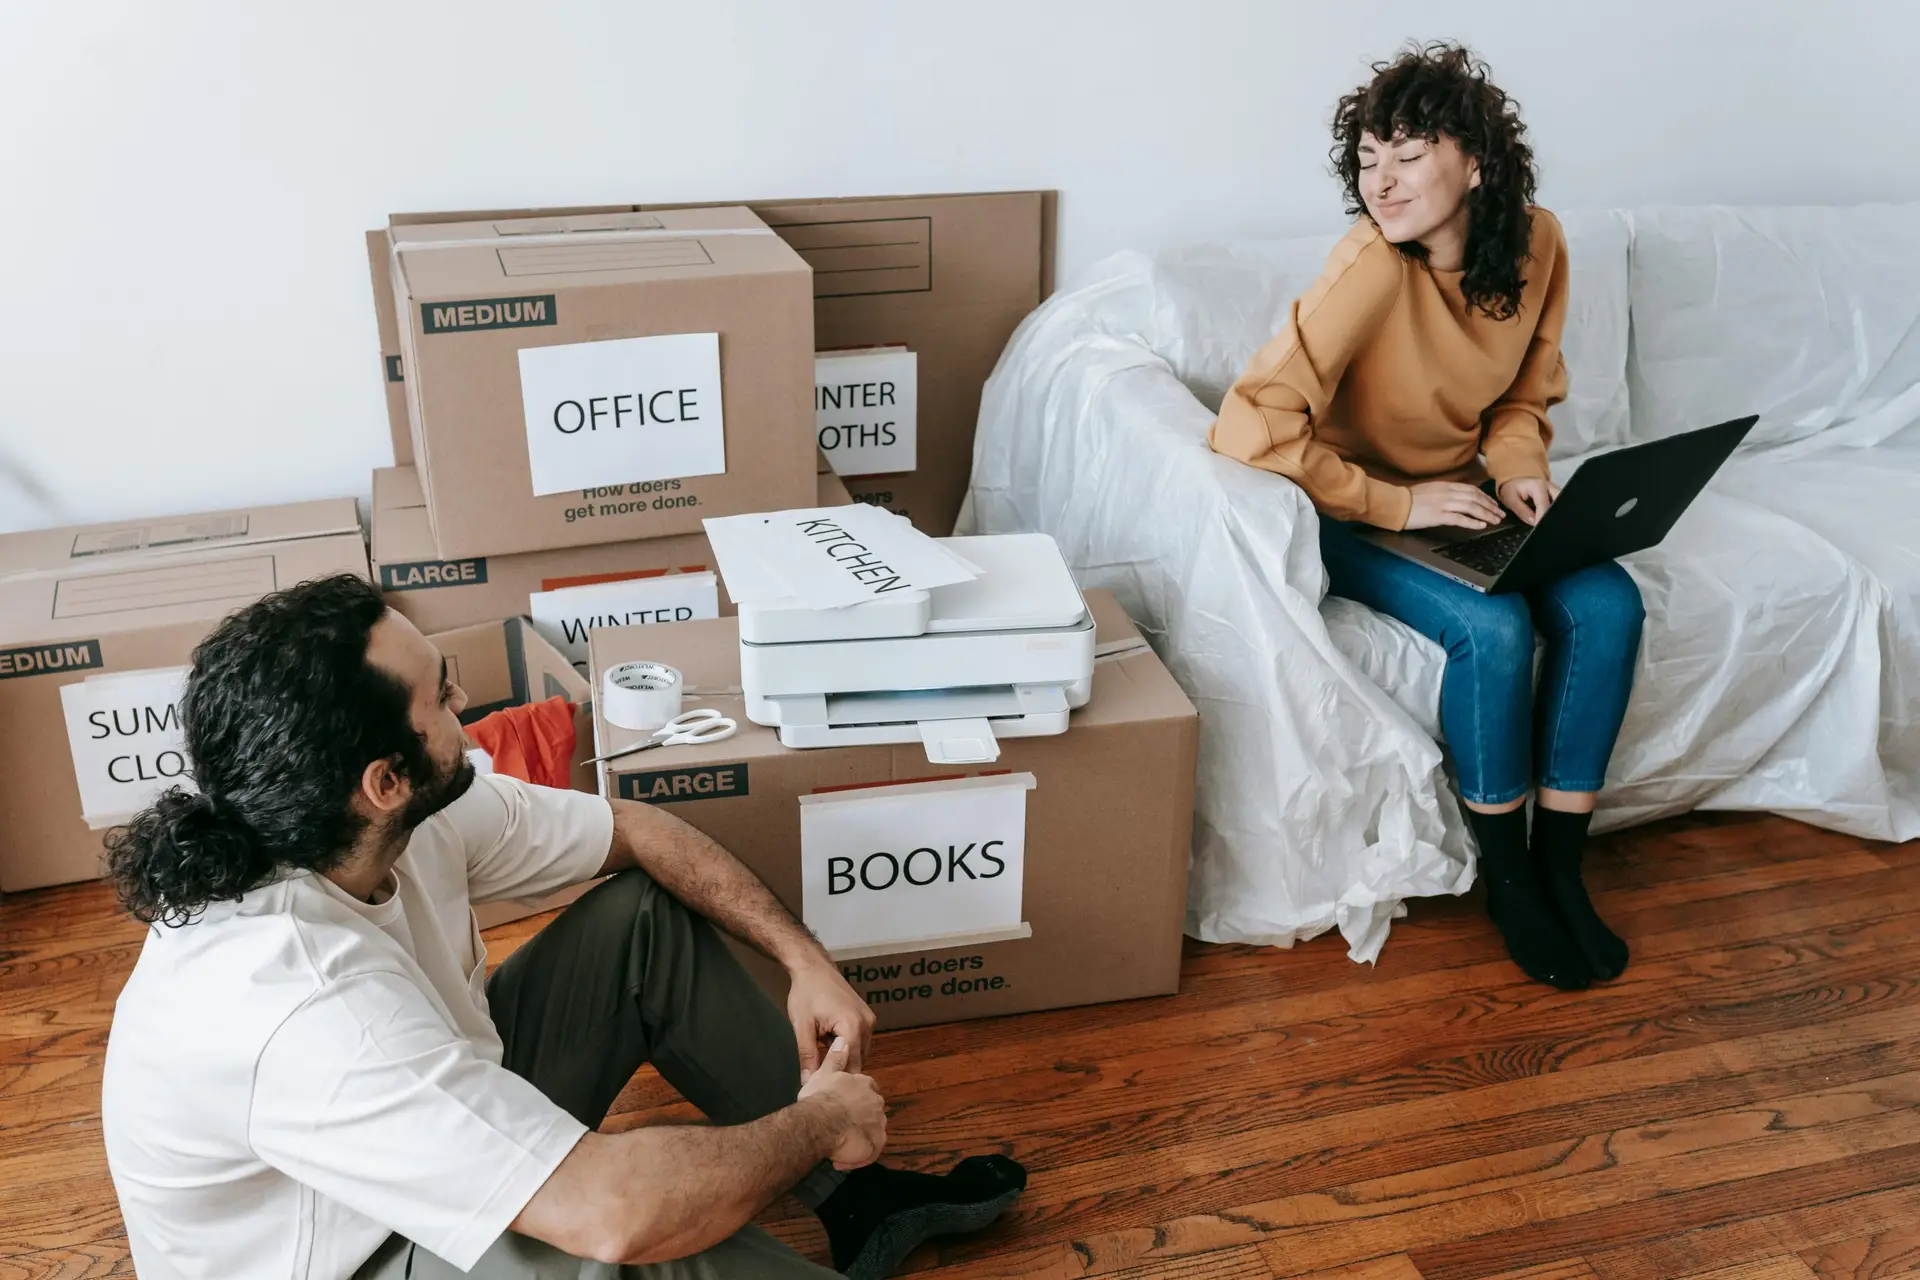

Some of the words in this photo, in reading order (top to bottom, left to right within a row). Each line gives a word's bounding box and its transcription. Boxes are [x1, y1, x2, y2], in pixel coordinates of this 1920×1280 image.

[433, 301, 546, 328] MEDIUM
[553, 388, 700, 434] OFFICE
[818, 421, 896, 450] OTHS
[582, 484, 624, 500] How
[629, 479, 682, 495] doers
[564, 503, 596, 523] get
[599, 501, 647, 517] more
[796, 518, 911, 593] KITCHEN
[390, 562, 477, 587] LARGE
[88, 703, 180, 739] SUM
[107, 750, 185, 783] CLO
[632, 770, 737, 800] LARGE
[828, 840, 1006, 896] BOOKS
[843, 964, 902, 983] How
[909, 954, 984, 977] doers
[866, 983, 933, 1005] more
